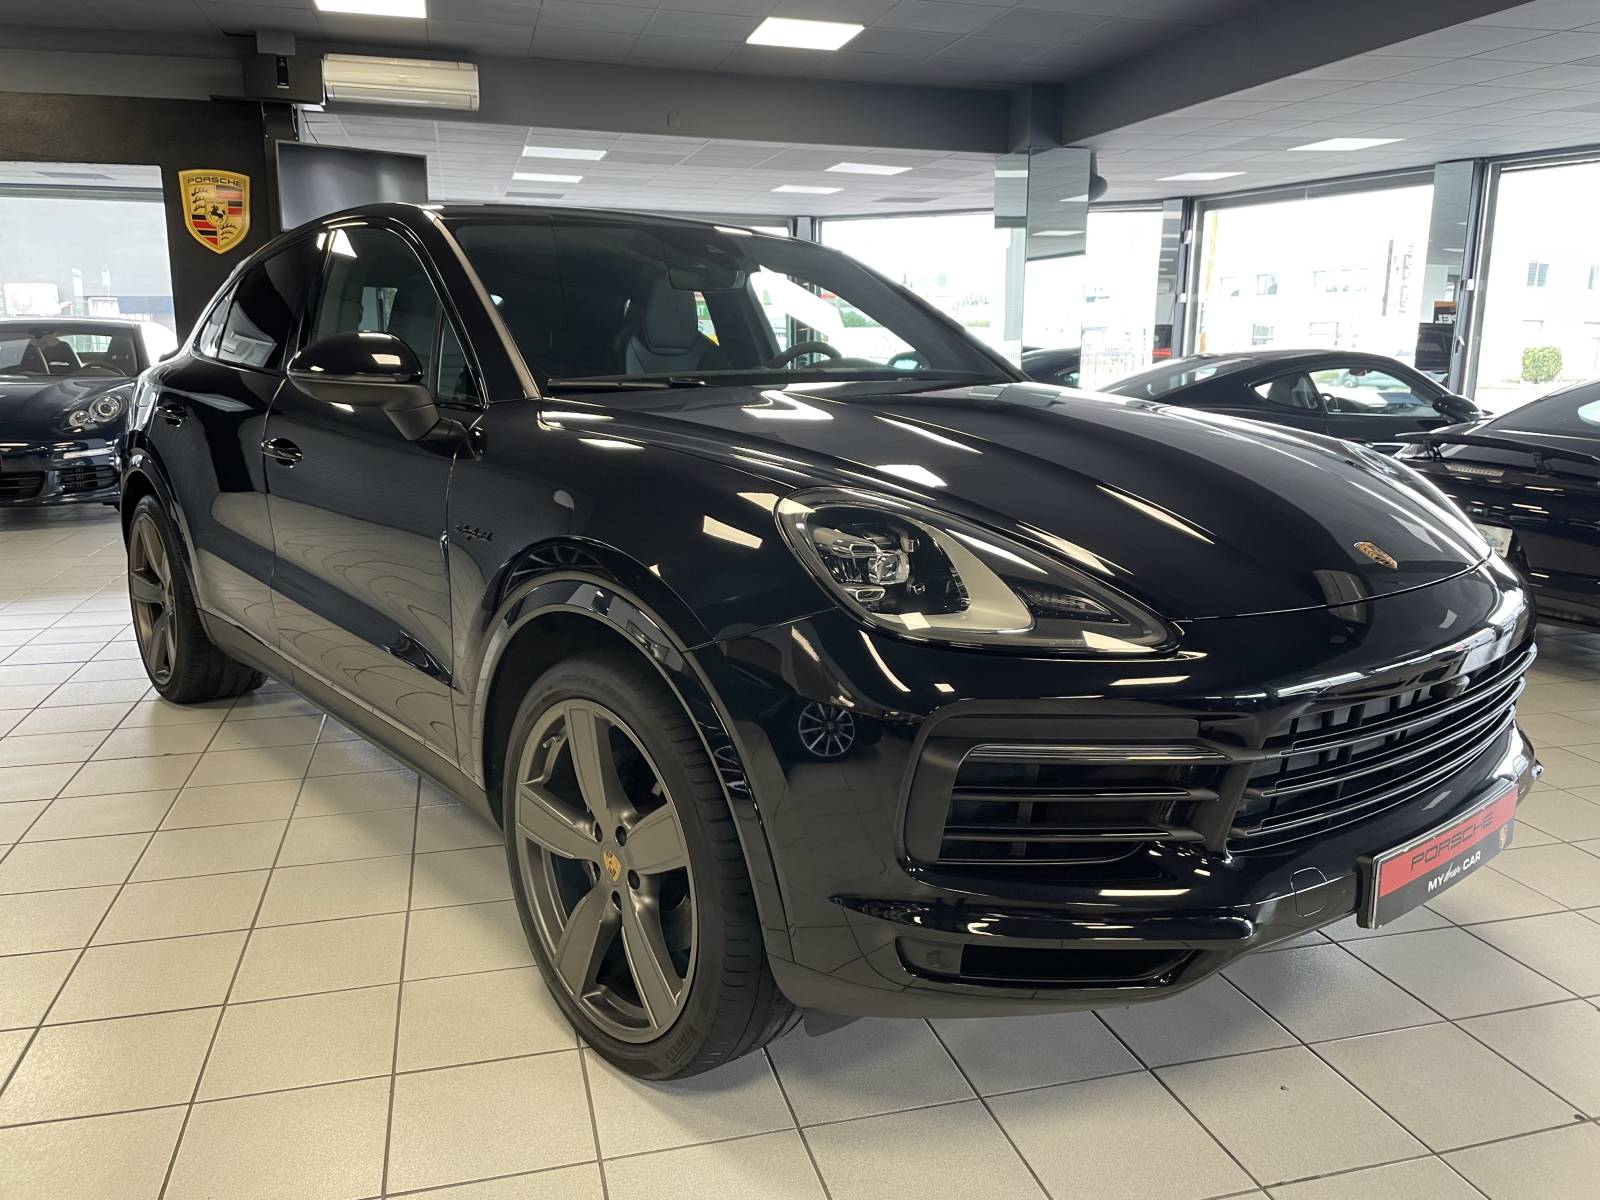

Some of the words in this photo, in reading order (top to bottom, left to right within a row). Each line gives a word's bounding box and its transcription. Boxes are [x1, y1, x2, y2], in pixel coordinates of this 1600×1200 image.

[187, 176, 241, 187] PORSCHE
[1411, 813, 1493, 872] PORSCHE
[1427, 873, 1445, 893] MY
[1463, 850, 1481, 871] CAR
